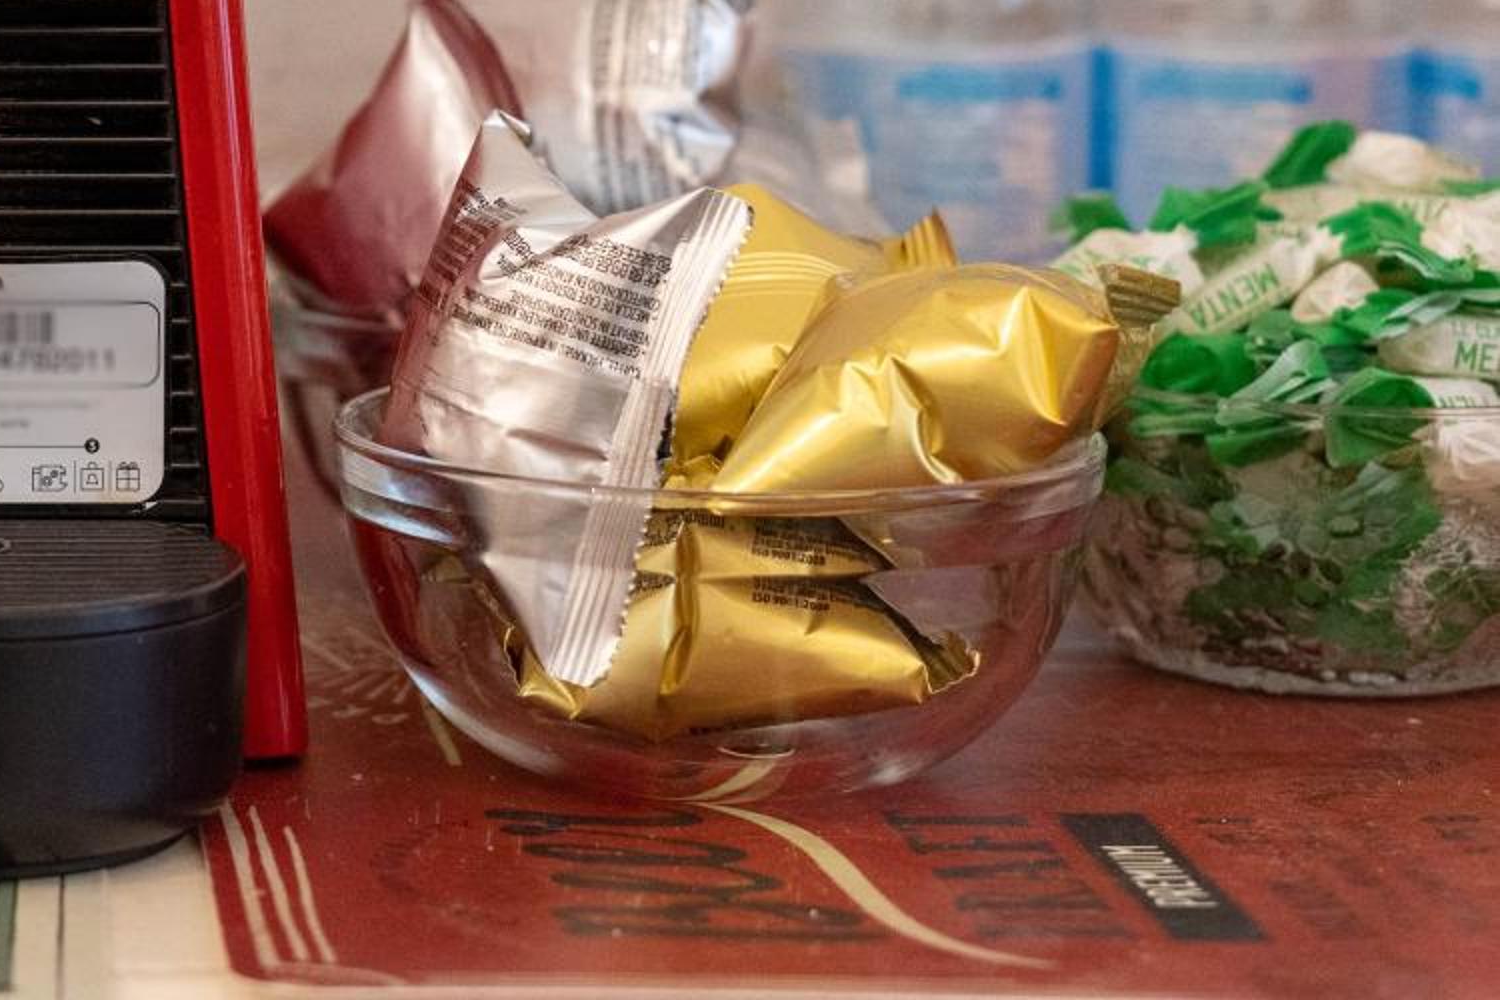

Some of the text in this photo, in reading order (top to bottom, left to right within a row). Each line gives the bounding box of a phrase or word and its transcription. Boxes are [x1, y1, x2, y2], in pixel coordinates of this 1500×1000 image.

[1182, 262, 1281, 330] MENTA
[1454, 340, 1500, 375] ME
[1099, 844, 1221, 909] PREMIUM
